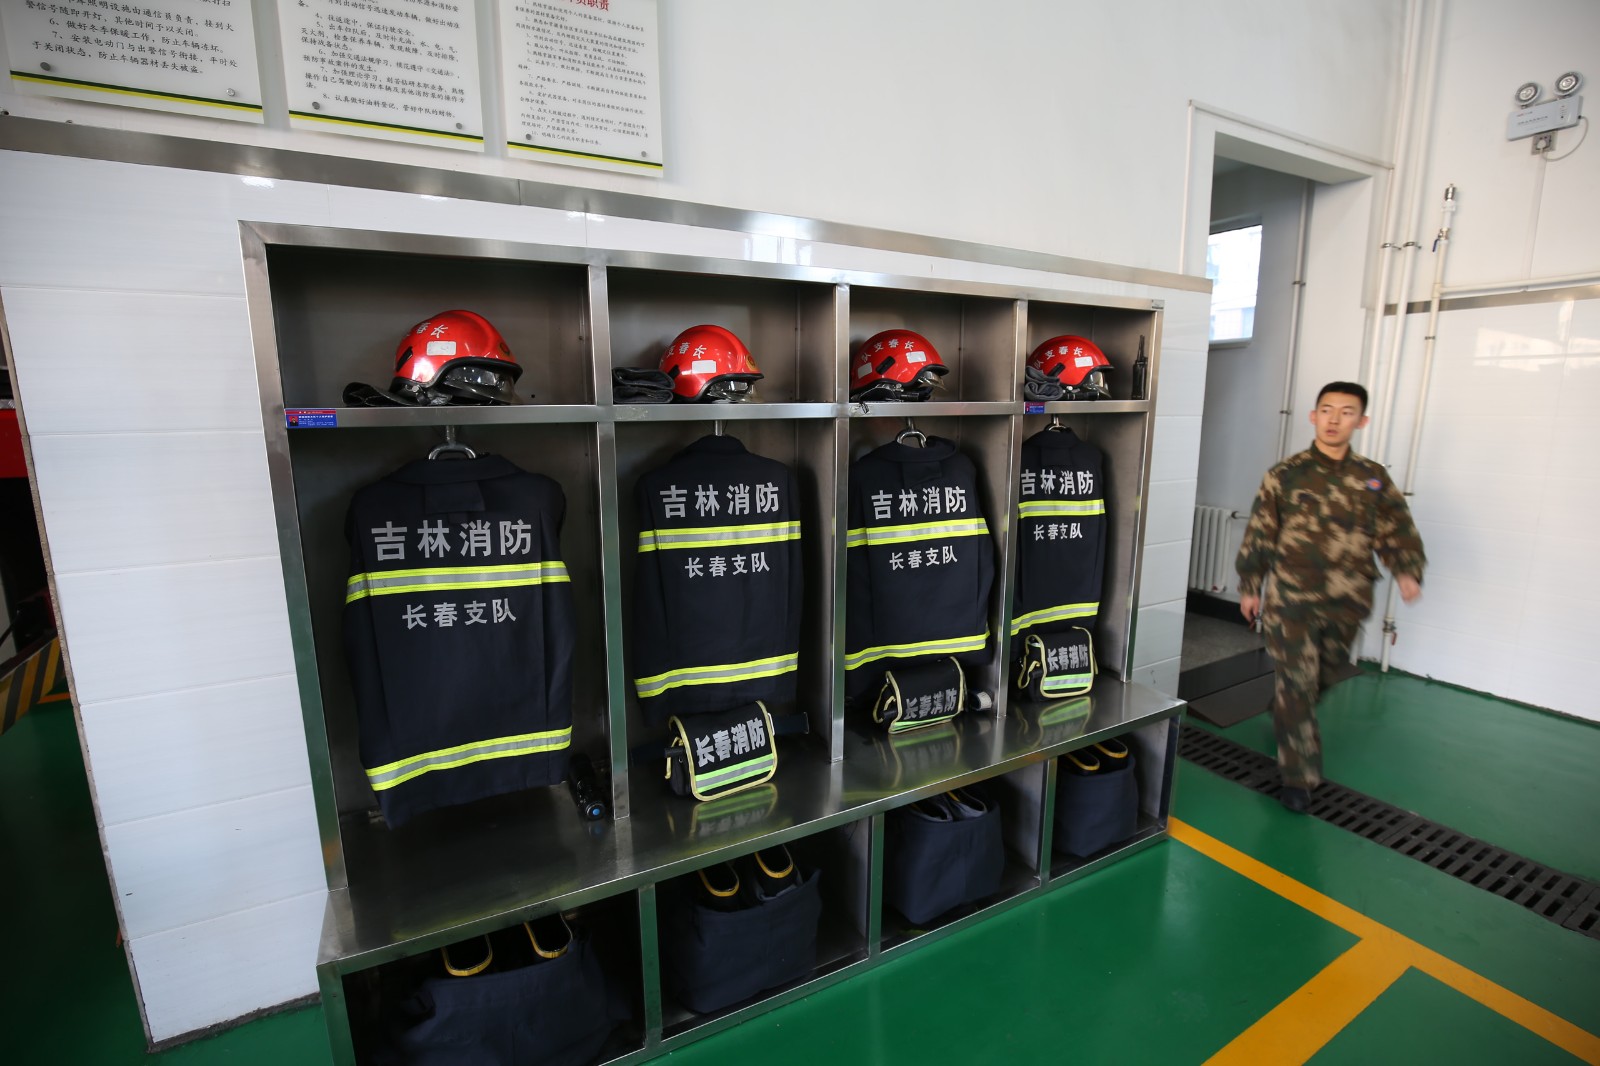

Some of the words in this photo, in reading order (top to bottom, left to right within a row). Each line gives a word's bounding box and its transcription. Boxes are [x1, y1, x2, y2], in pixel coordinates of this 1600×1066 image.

[1020, 468, 1095, 496] 吉林消防
[660, 481, 780, 519] 吉林消防
[871, 485, 968, 520] 吉林消防
[371, 519, 532, 561] 吉林消防
[1033, 522, 1083, 541] 长春支队
[684, 551, 771, 579] 长春支队
[889, 545, 958, 571] 长春支队
[401, 598, 517, 630] 长春支队
[1045, 642, 1090, 672] 长春消防
[902, 687, 958, 722] 长春消防
[694, 716, 766, 768] 长春消防
